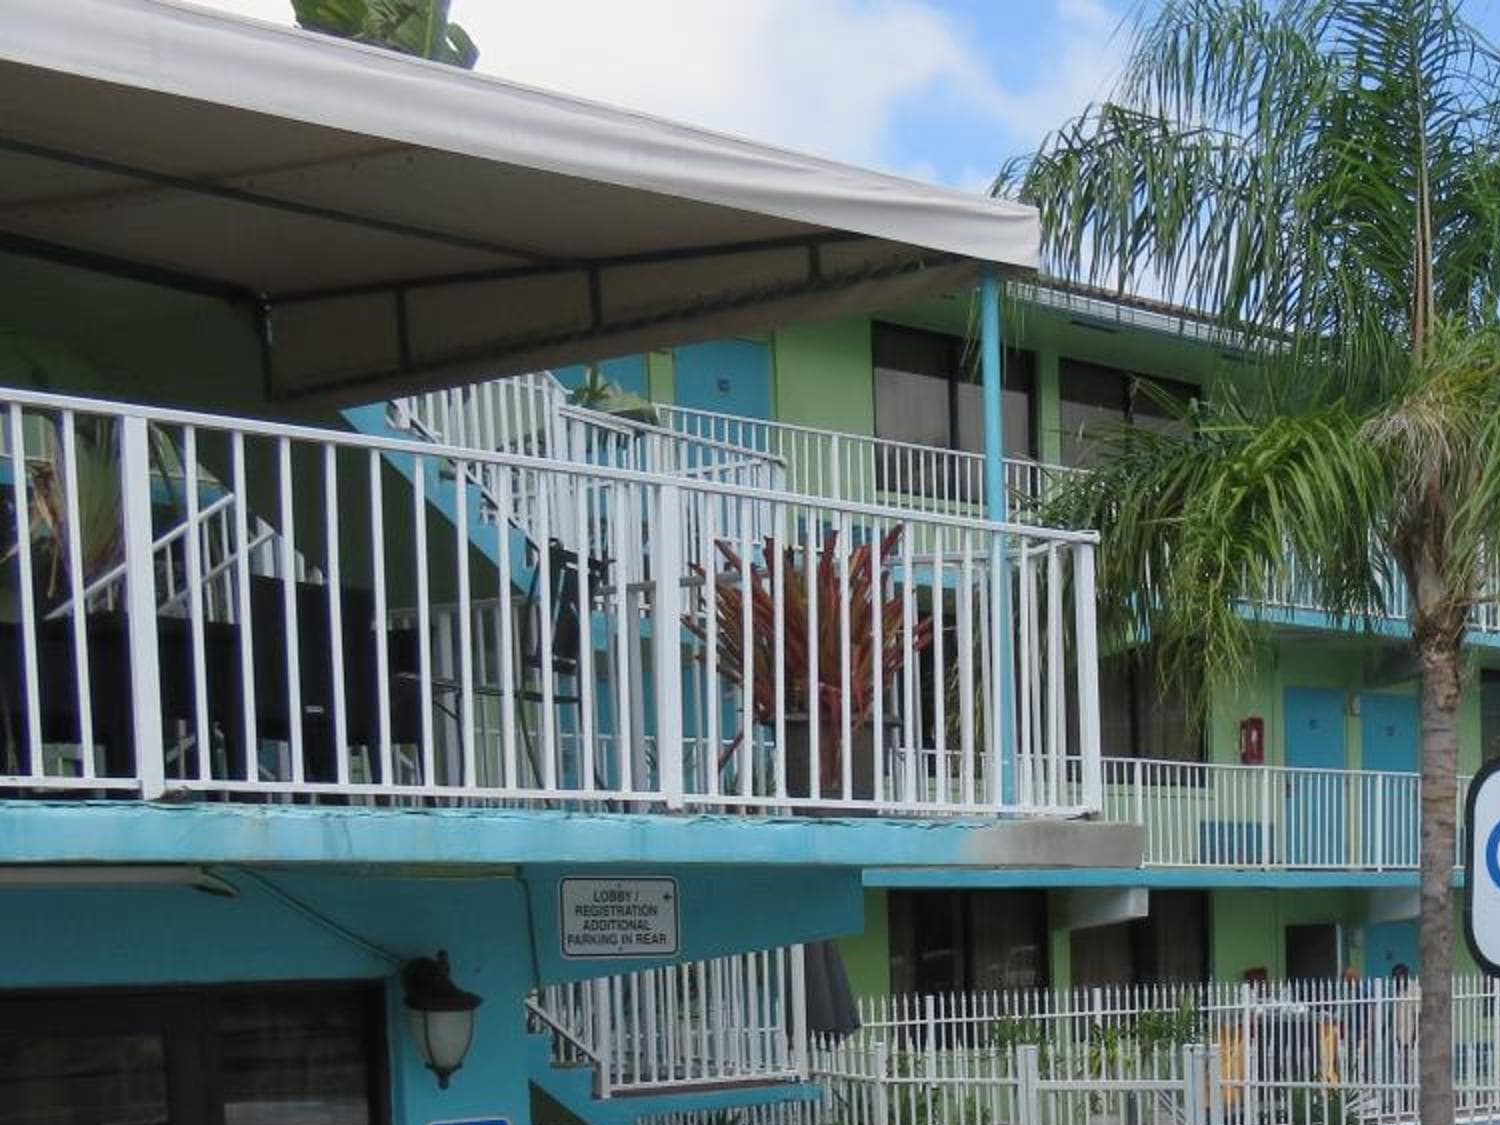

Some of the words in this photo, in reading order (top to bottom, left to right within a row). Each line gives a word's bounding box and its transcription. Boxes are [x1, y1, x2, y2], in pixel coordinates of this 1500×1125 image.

[593, 890, 632, 902] LOBBY
[575, 905, 658, 917] REGISTRATION
[583, 920, 651, 931] ADDITIONAL
[567, 934, 618, 945] PARKING
[621, 934, 633, 944] IN
[635, 933, 667, 945] REAR
